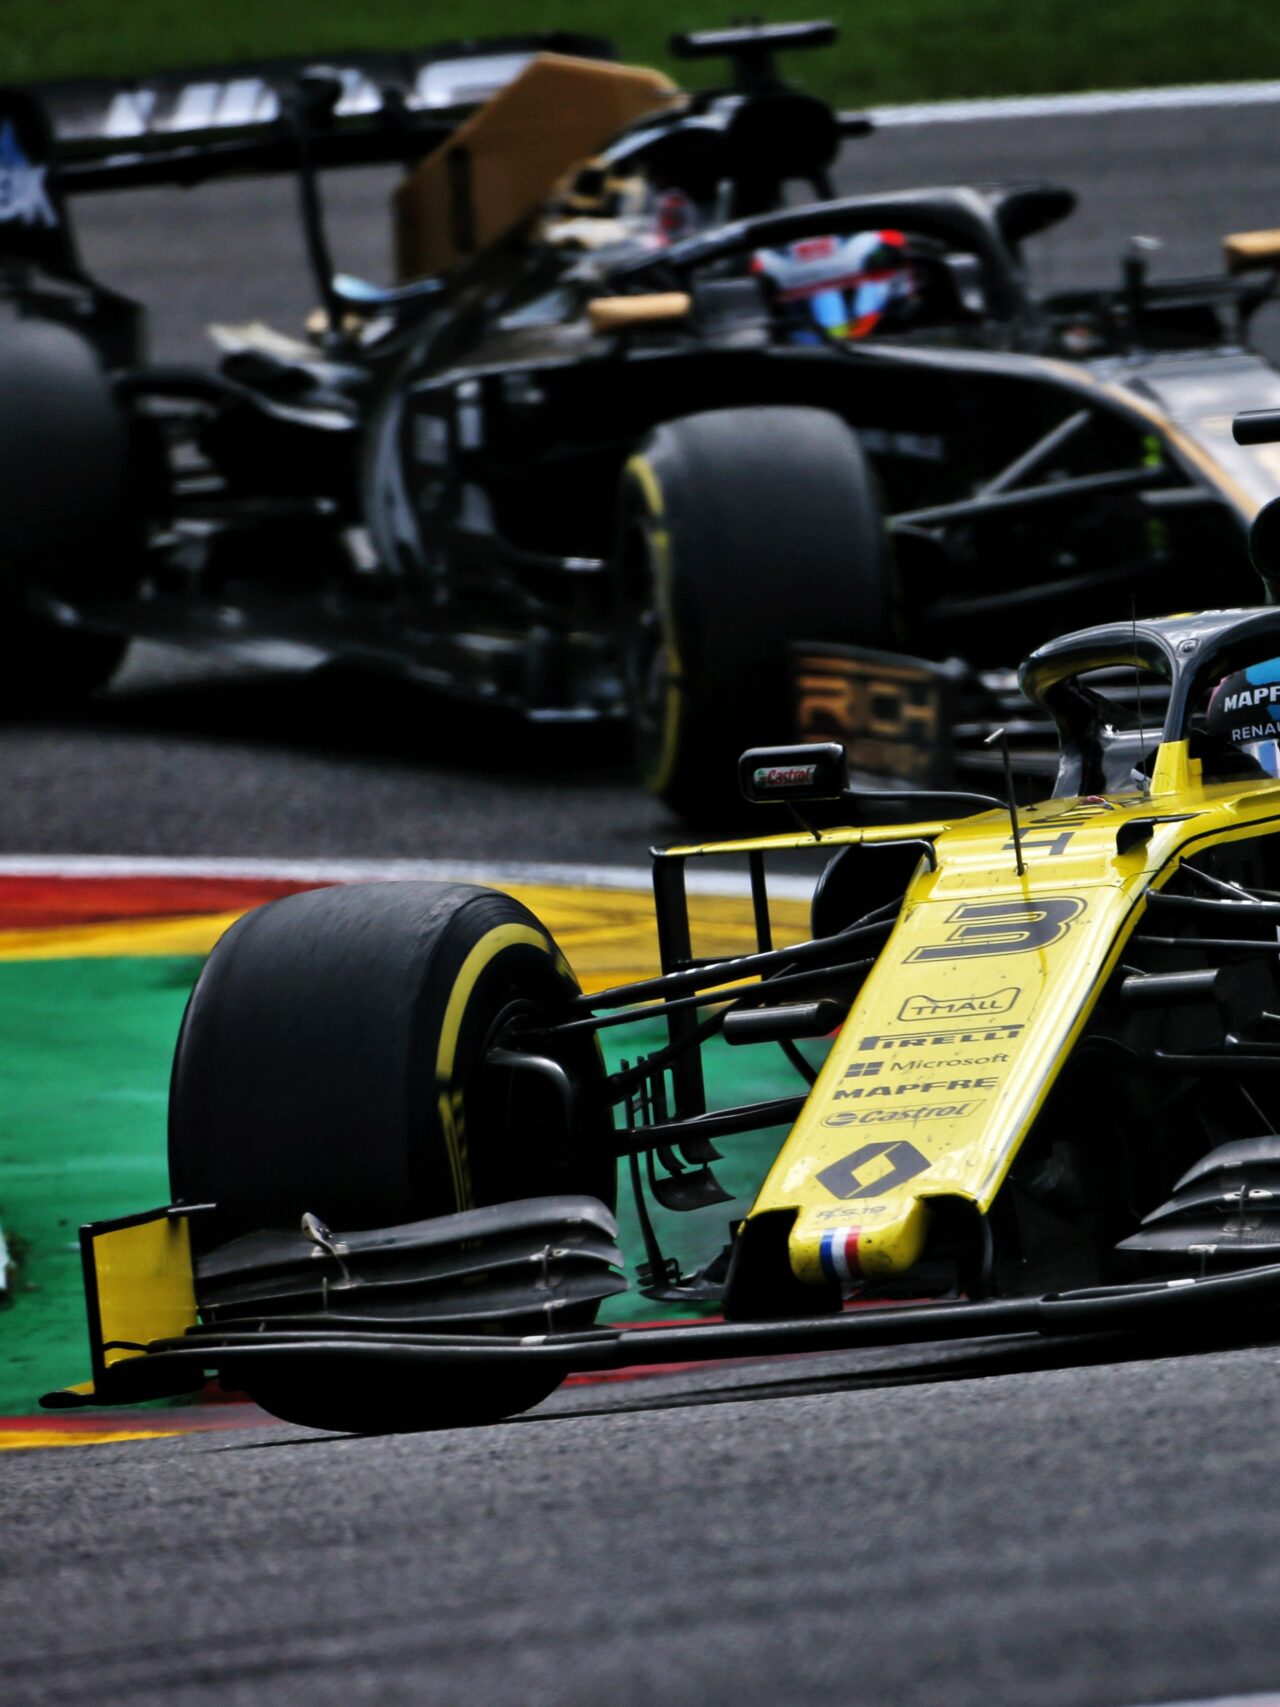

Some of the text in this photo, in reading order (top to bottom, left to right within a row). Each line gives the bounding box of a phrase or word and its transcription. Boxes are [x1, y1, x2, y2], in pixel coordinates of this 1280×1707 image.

[766, 767, 811, 786] Castrol
[902, 896, 1088, 965] 3
[911, 1001, 1003, 1016] TMALL
[858, 1023, 1025, 1051] PIRELLI
[890, 1053, 1010, 1072] Microsoft
[832, 1076, 999, 1100] MAPFRE
[859, 1103, 967, 1122] Castrol
